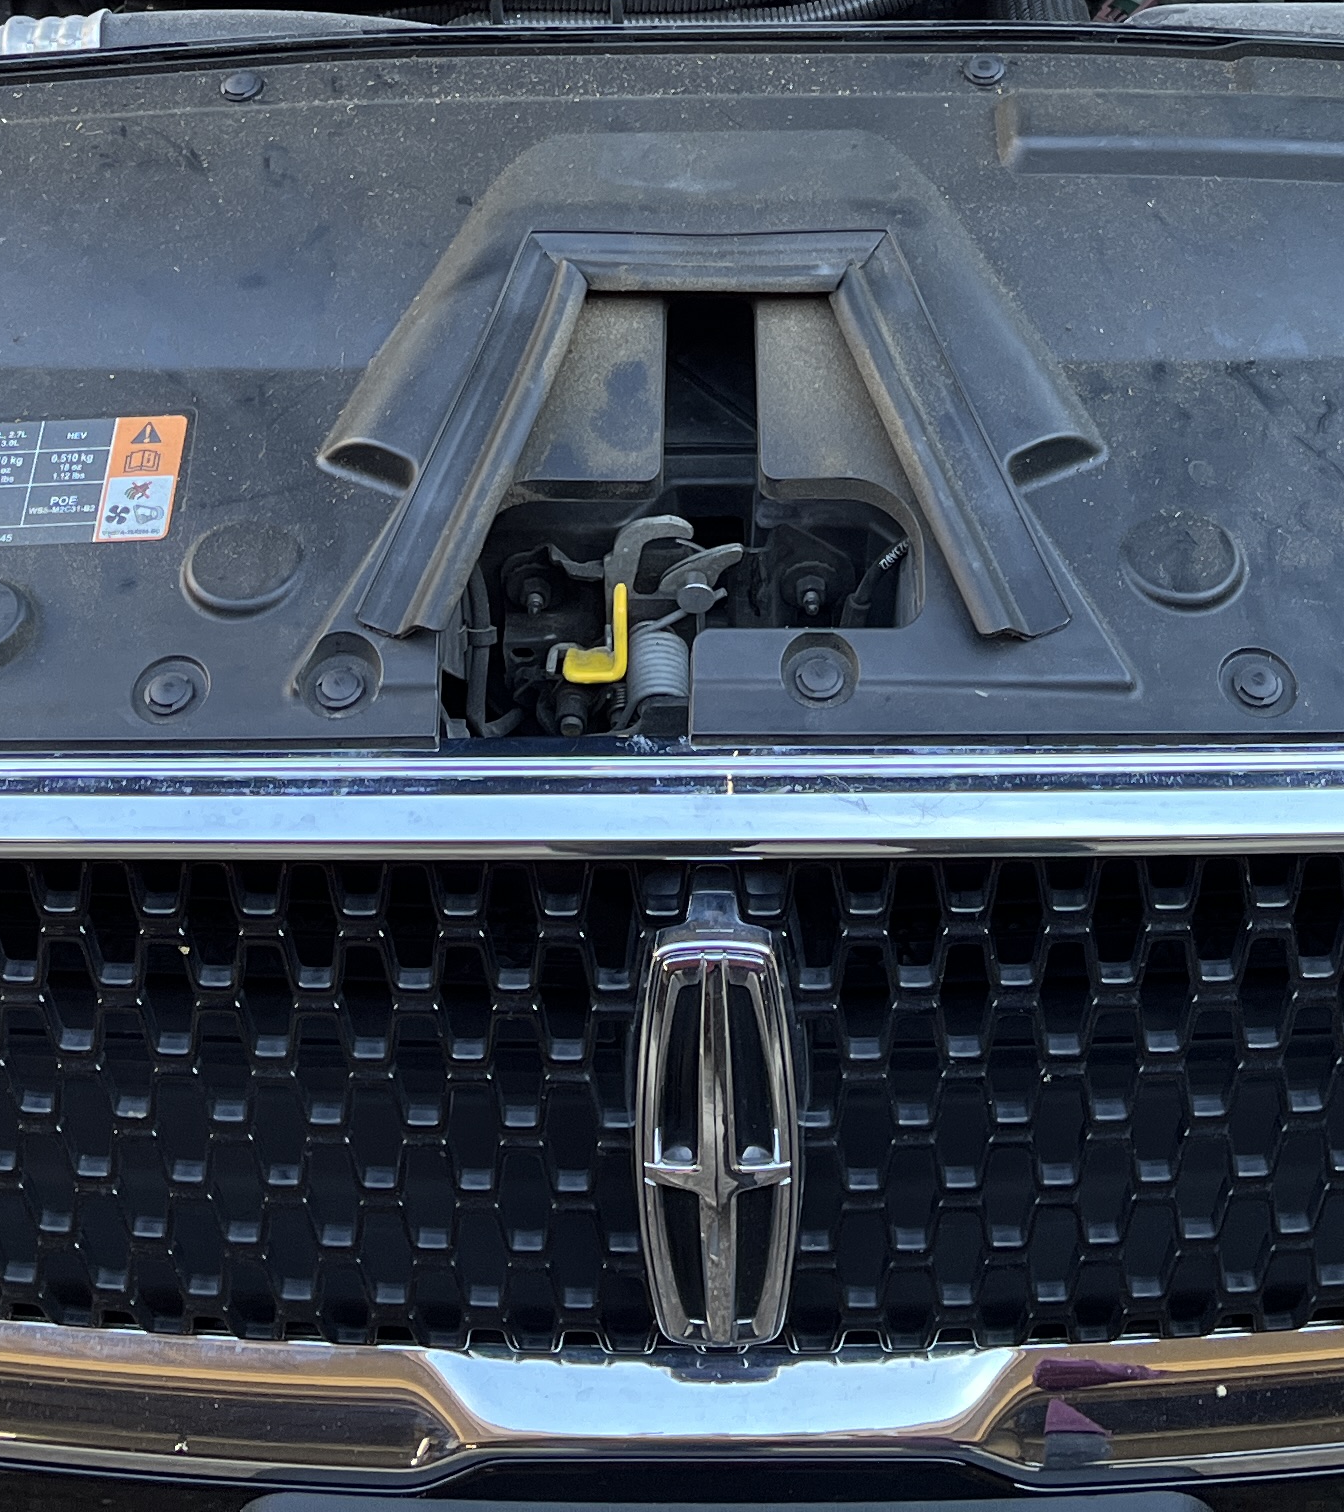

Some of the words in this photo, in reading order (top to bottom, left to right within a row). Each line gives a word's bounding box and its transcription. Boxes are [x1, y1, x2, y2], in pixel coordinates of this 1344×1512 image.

[9, 430, 27, 439] 2.7L
[66, 431, 88, 440] HEV
[1, 439, 19, 447] 3.0L
[10, 455, 24, 467] kg
[50, 453, 78, 463] 0.510
[80, 452, 95, 464] kg
[59, 463, 69, 471] 18
[1, 475, 15, 484] lbs
[52, 472, 71, 481] 1.12
[72, 471, 86, 480] lbs
[49, 495, 79, 506] POE
